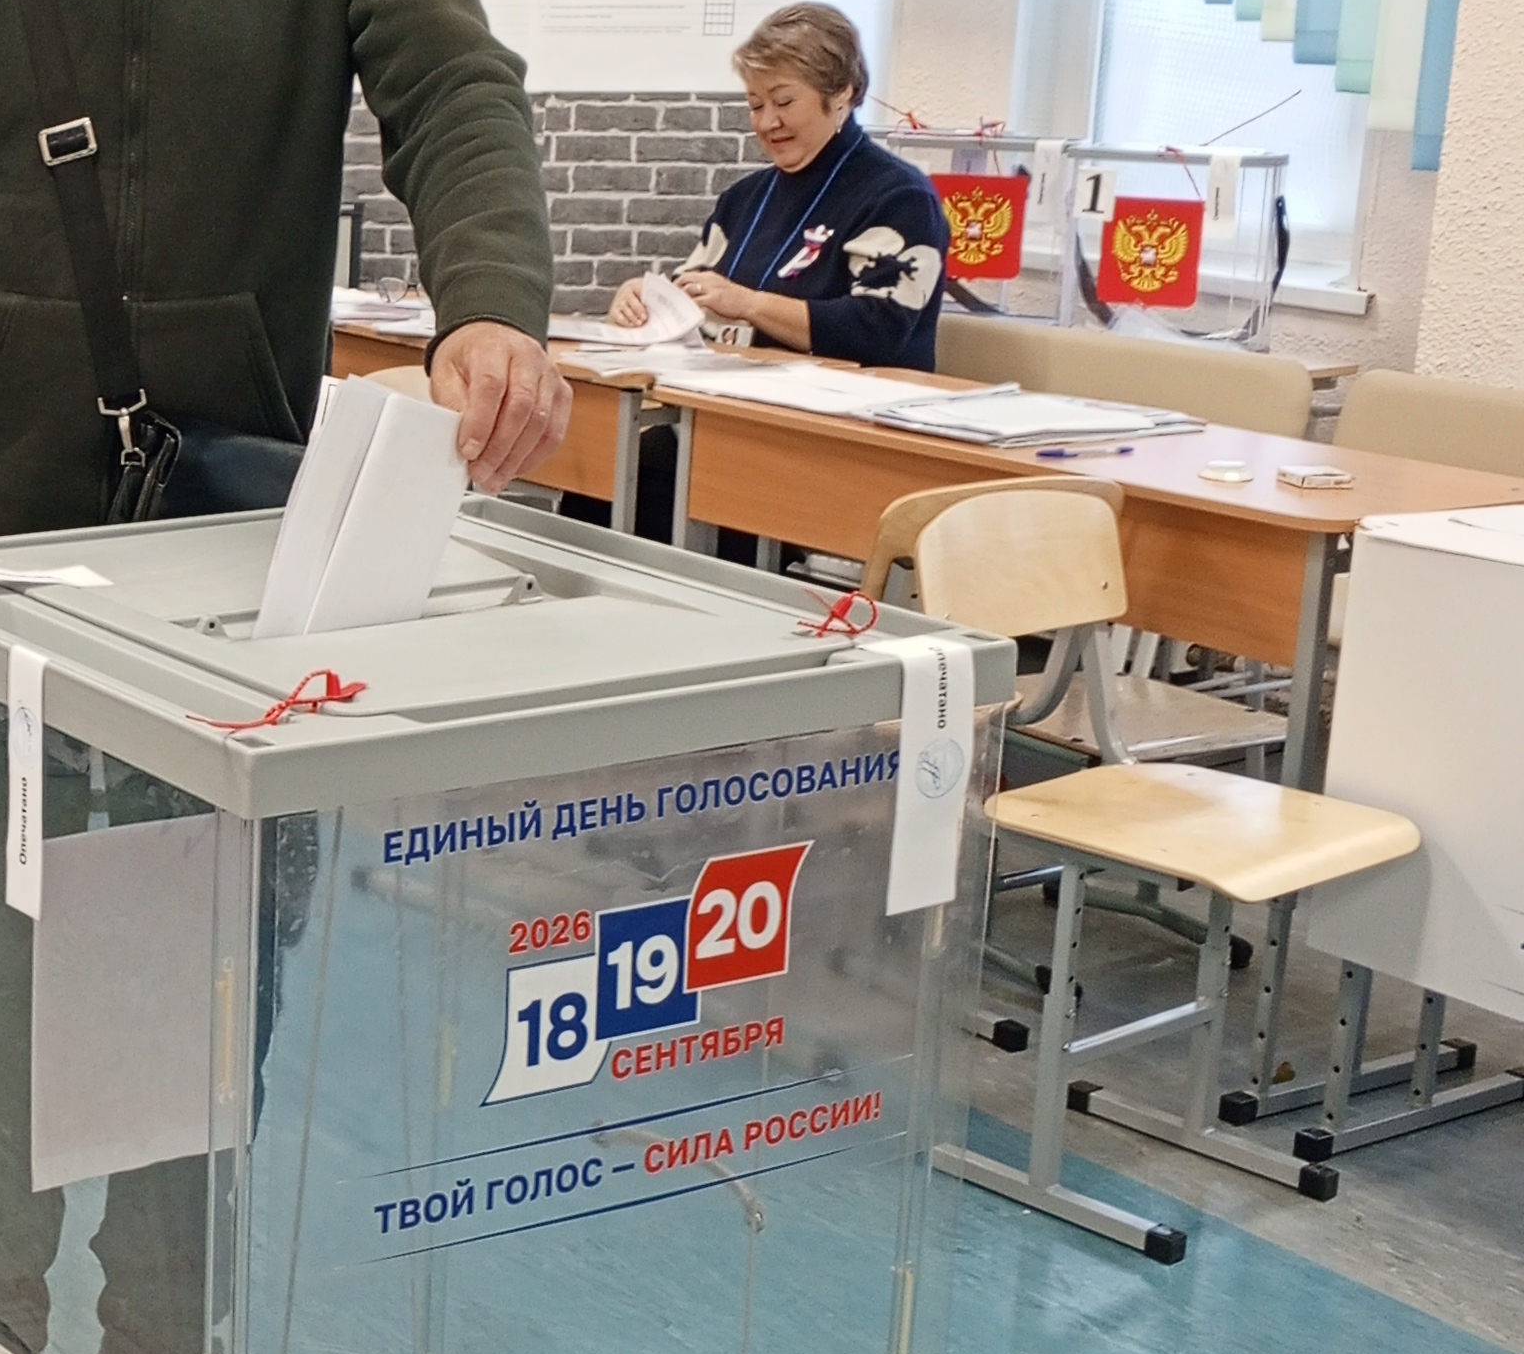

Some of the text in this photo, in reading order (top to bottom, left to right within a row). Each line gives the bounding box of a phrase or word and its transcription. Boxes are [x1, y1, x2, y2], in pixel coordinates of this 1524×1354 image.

[1082, 173, 1105, 214] 1
[18, 776, 28, 865] Опечатано
[383, 749, 900, 865] ЕДИНЫЙ ДЕНЬ ГОЛОСОВАНИЯ
[509, 911, 592, 954] 2026
[518, 881, 782, 1067] 18 19 20
[611, 1017, 785, 1079] СЕНТЯБРЯ
[374, 1178, 473, 1234] ТВОЙ
[486, 1157, 603, 1210] ГОЛОС
[644, 1132, 735, 1175] СИЛА
[744, 1092, 881, 1151] РОССИИ!
